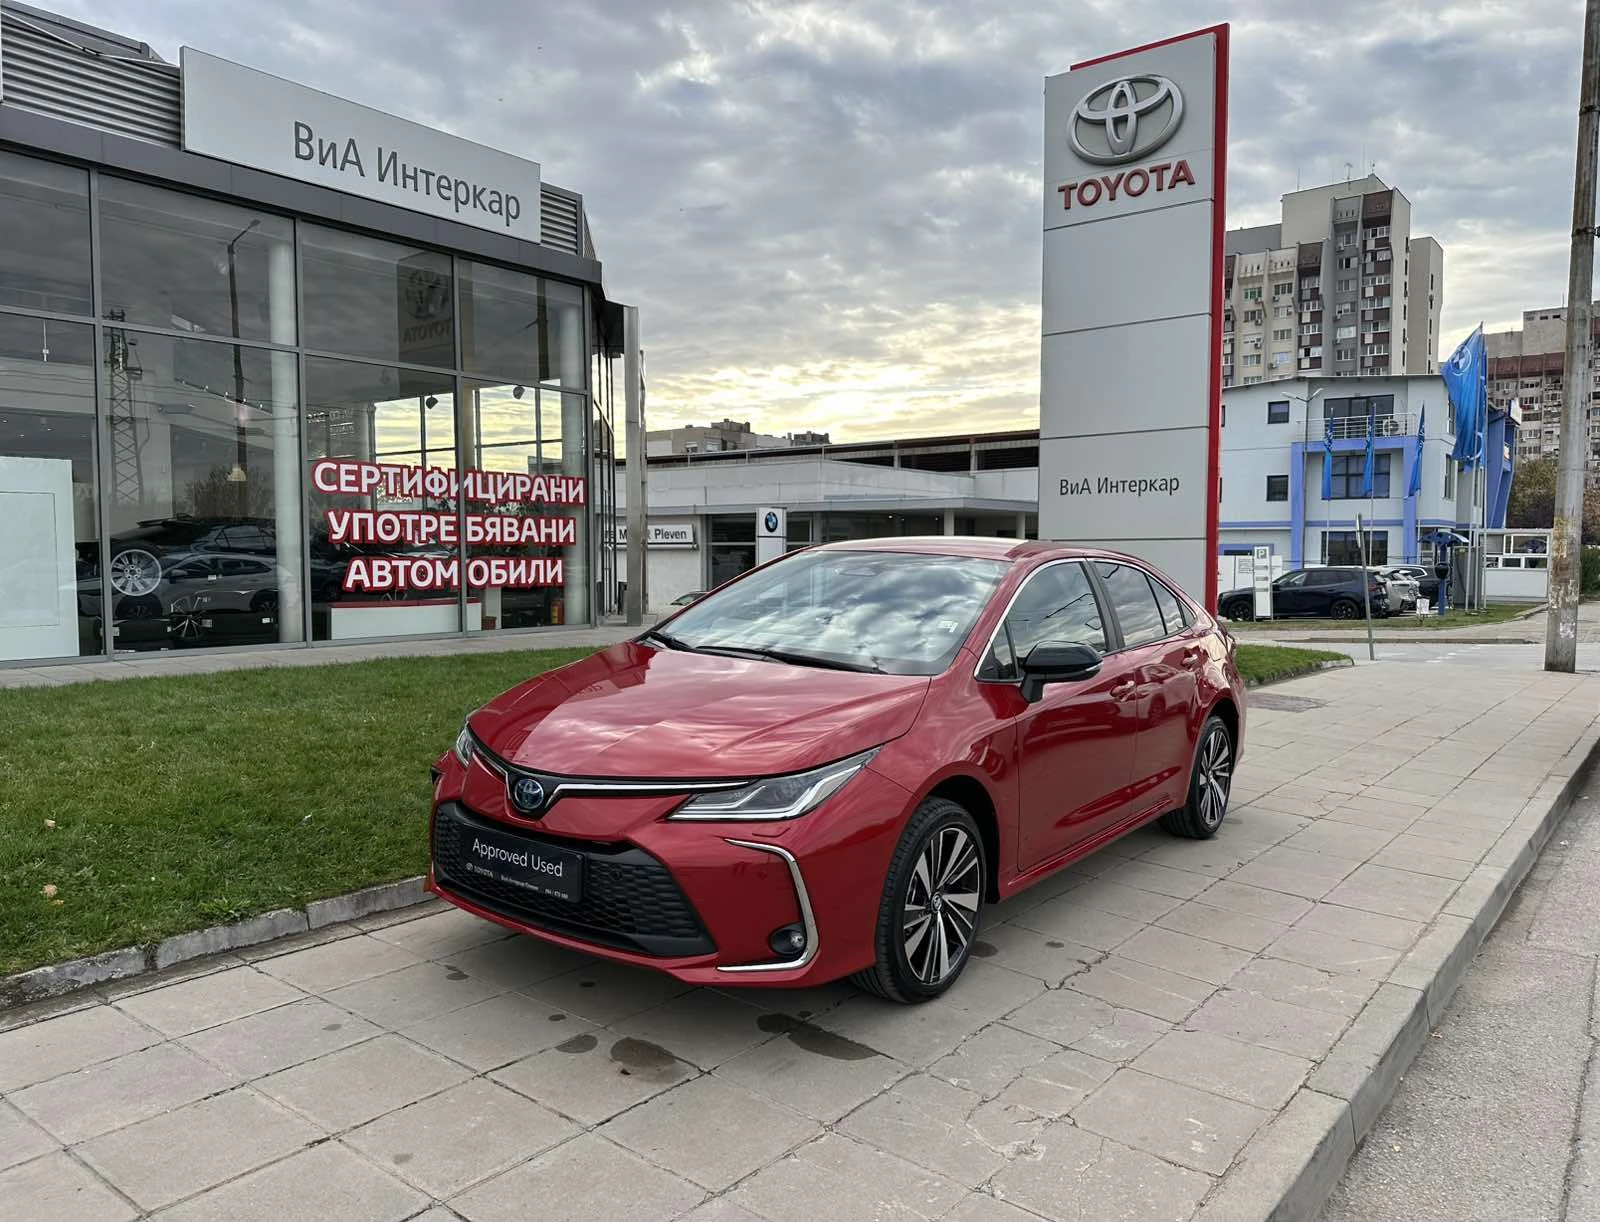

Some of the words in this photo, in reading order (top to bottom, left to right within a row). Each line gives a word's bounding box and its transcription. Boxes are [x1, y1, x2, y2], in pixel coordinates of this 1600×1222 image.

[294, 120, 366, 177] ВиА
[377, 146, 521, 227] Интеркар
[1057, 159, 1196, 210] TOYOTA
[313, 461, 585, 504] СЕРТИФИЦИРАНИ
[1059, 478, 1092, 496] ВиА
[1097, 477, 1180, 496] Интеркар
[654, 528, 687, 540] Pleven
[344, 558, 564, 589] АВТОМОБИЛИ
[472, 837, 528, 867] Approved
[531, 854, 563, 877] Used
